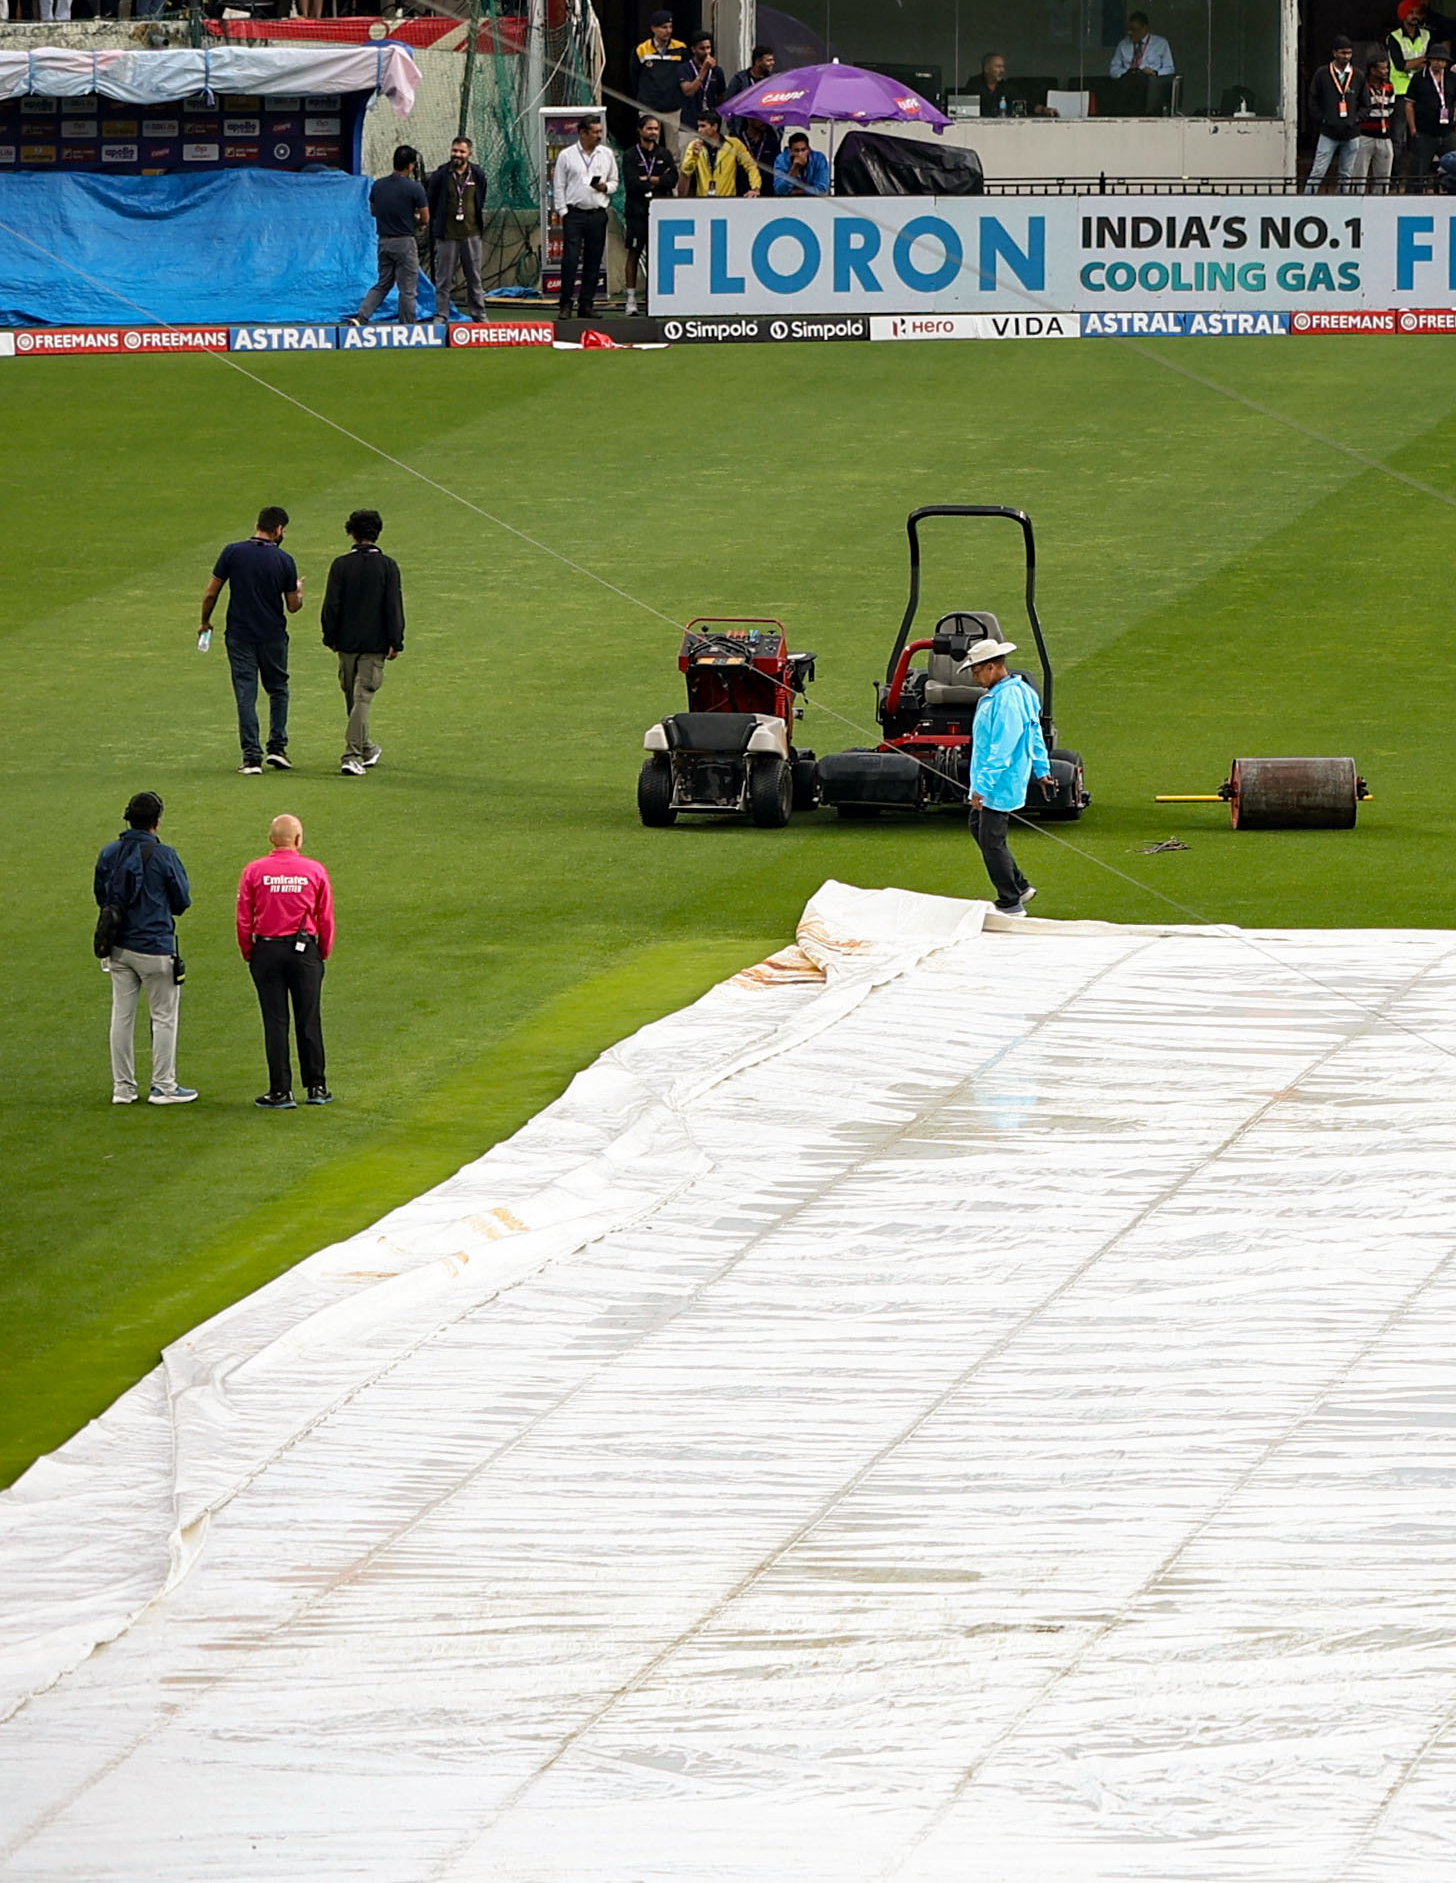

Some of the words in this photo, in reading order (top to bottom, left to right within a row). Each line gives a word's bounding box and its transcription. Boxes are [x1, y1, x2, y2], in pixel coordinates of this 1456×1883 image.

[1260, 216, 1361, 249] NO.1
[657, 216, 1045, 295] FLORON
[1080, 262, 1266, 292] COOLING
[1277, 262, 1361, 292] GAS
[687, 320, 758, 340] Simpolo
[792, 319, 863, 339] Simpolo
[993, 317, 1064, 336] VIDA
[1085, 313, 1181, 334] ASTRAL
[1191, 314, 1286, 335] ASTRAL
[1311, 316, 1394, 330] FREEMANS
[35, 333, 119, 349] FREEMANS
[142, 332, 226, 347] FREEMANS
[234, 327, 332, 349] ASTRAL
[344, 325, 441, 347] ASTRAL
[471, 327, 552, 343] FREEMANS
[263, 875, 309, 886] Emirates
